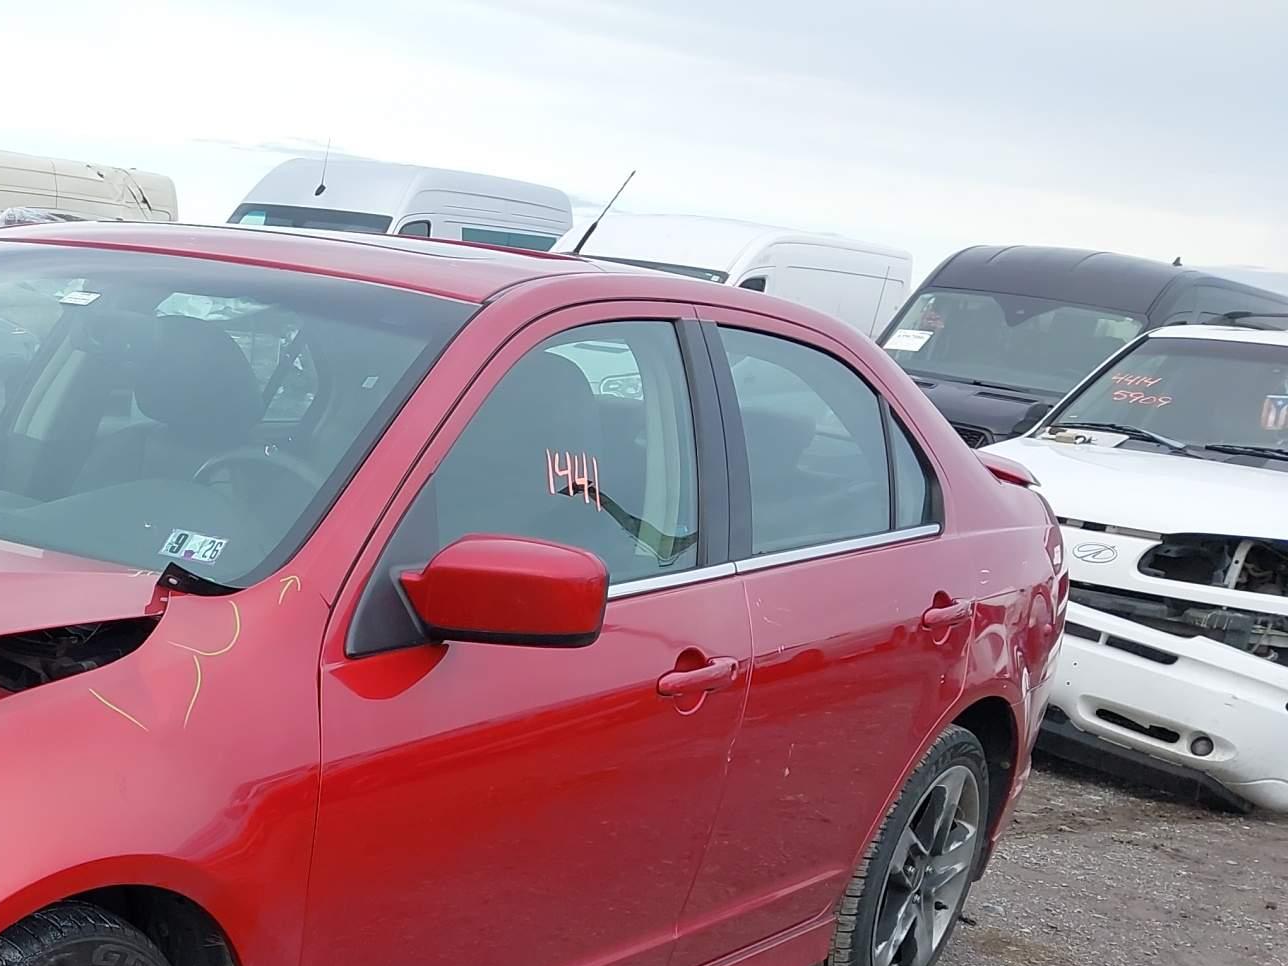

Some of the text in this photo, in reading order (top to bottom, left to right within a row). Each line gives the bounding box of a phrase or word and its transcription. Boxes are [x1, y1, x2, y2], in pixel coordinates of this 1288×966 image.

[1112, 373, 1163, 388] 4414
[1113, 389, 1173, 408] 5909
[545, 448, 602, 512] 1441
[168, 532, 224, 560] 9 26
